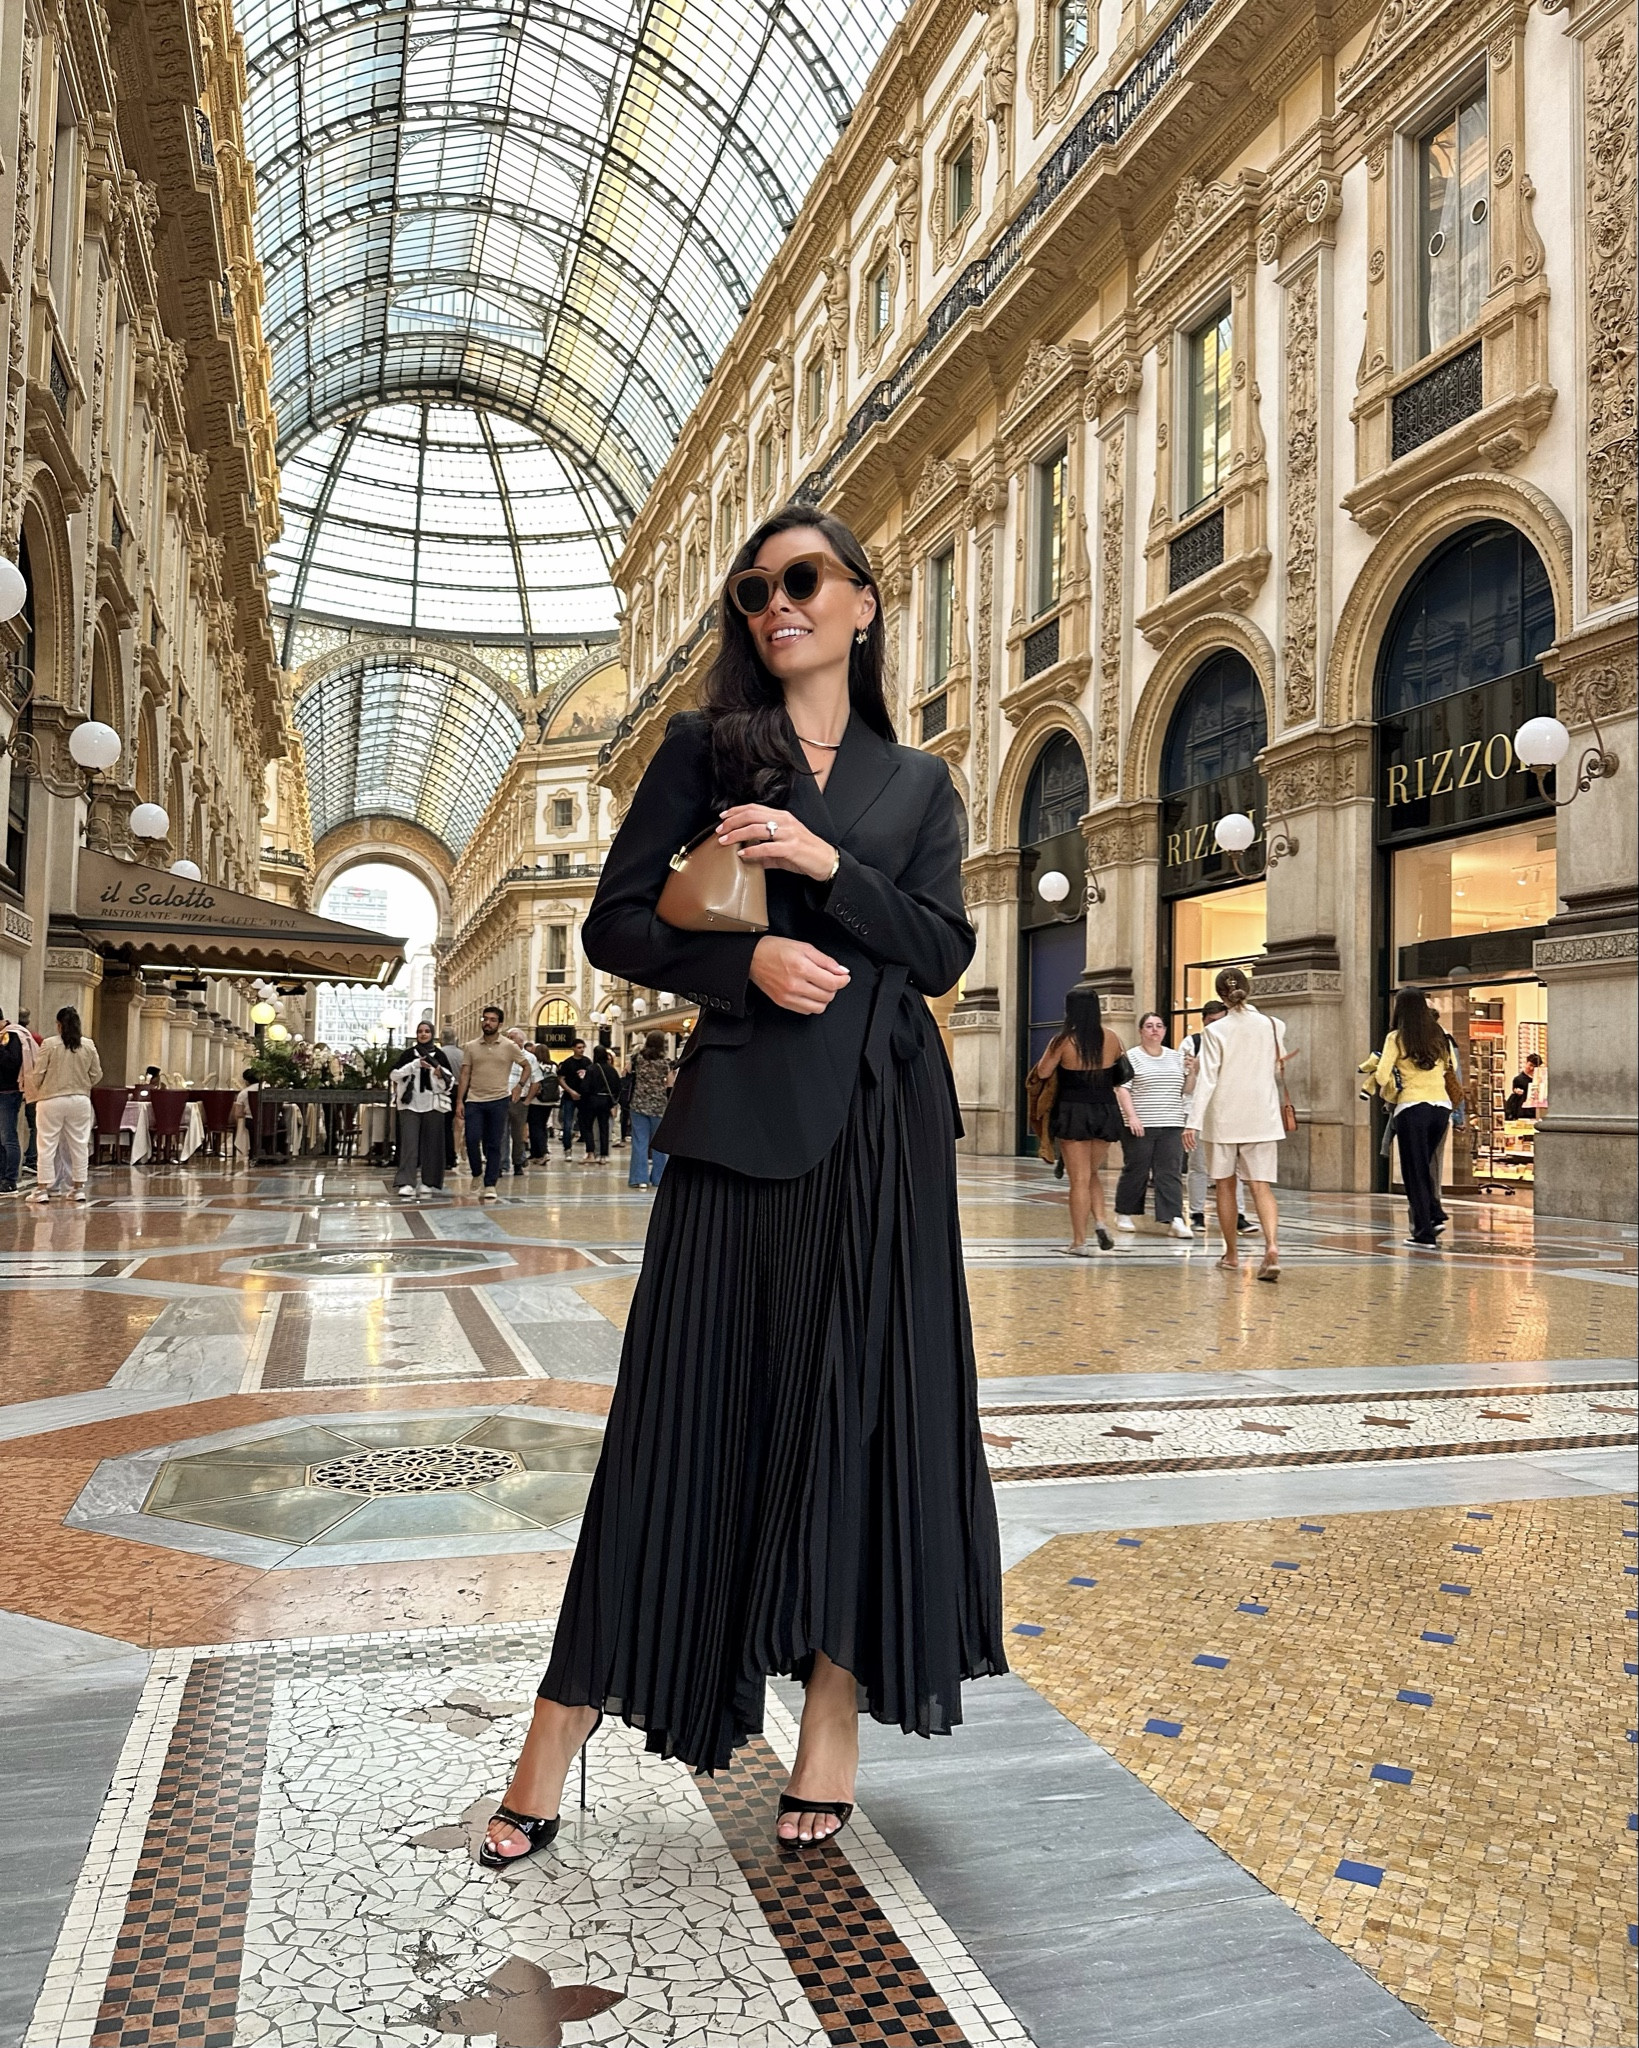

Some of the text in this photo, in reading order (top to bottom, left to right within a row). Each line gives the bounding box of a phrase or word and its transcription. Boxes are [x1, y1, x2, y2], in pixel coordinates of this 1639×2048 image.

[1386, 730, 1530, 807] RIZZO
[100, 881, 215, 909] il Salotto
[101, 908, 172, 920] RISTORANTE
[181, 913, 212, 922] PIZZA
[270, 919, 297, 928] WINE
[545, 1033, 567, 1042] DIOR
